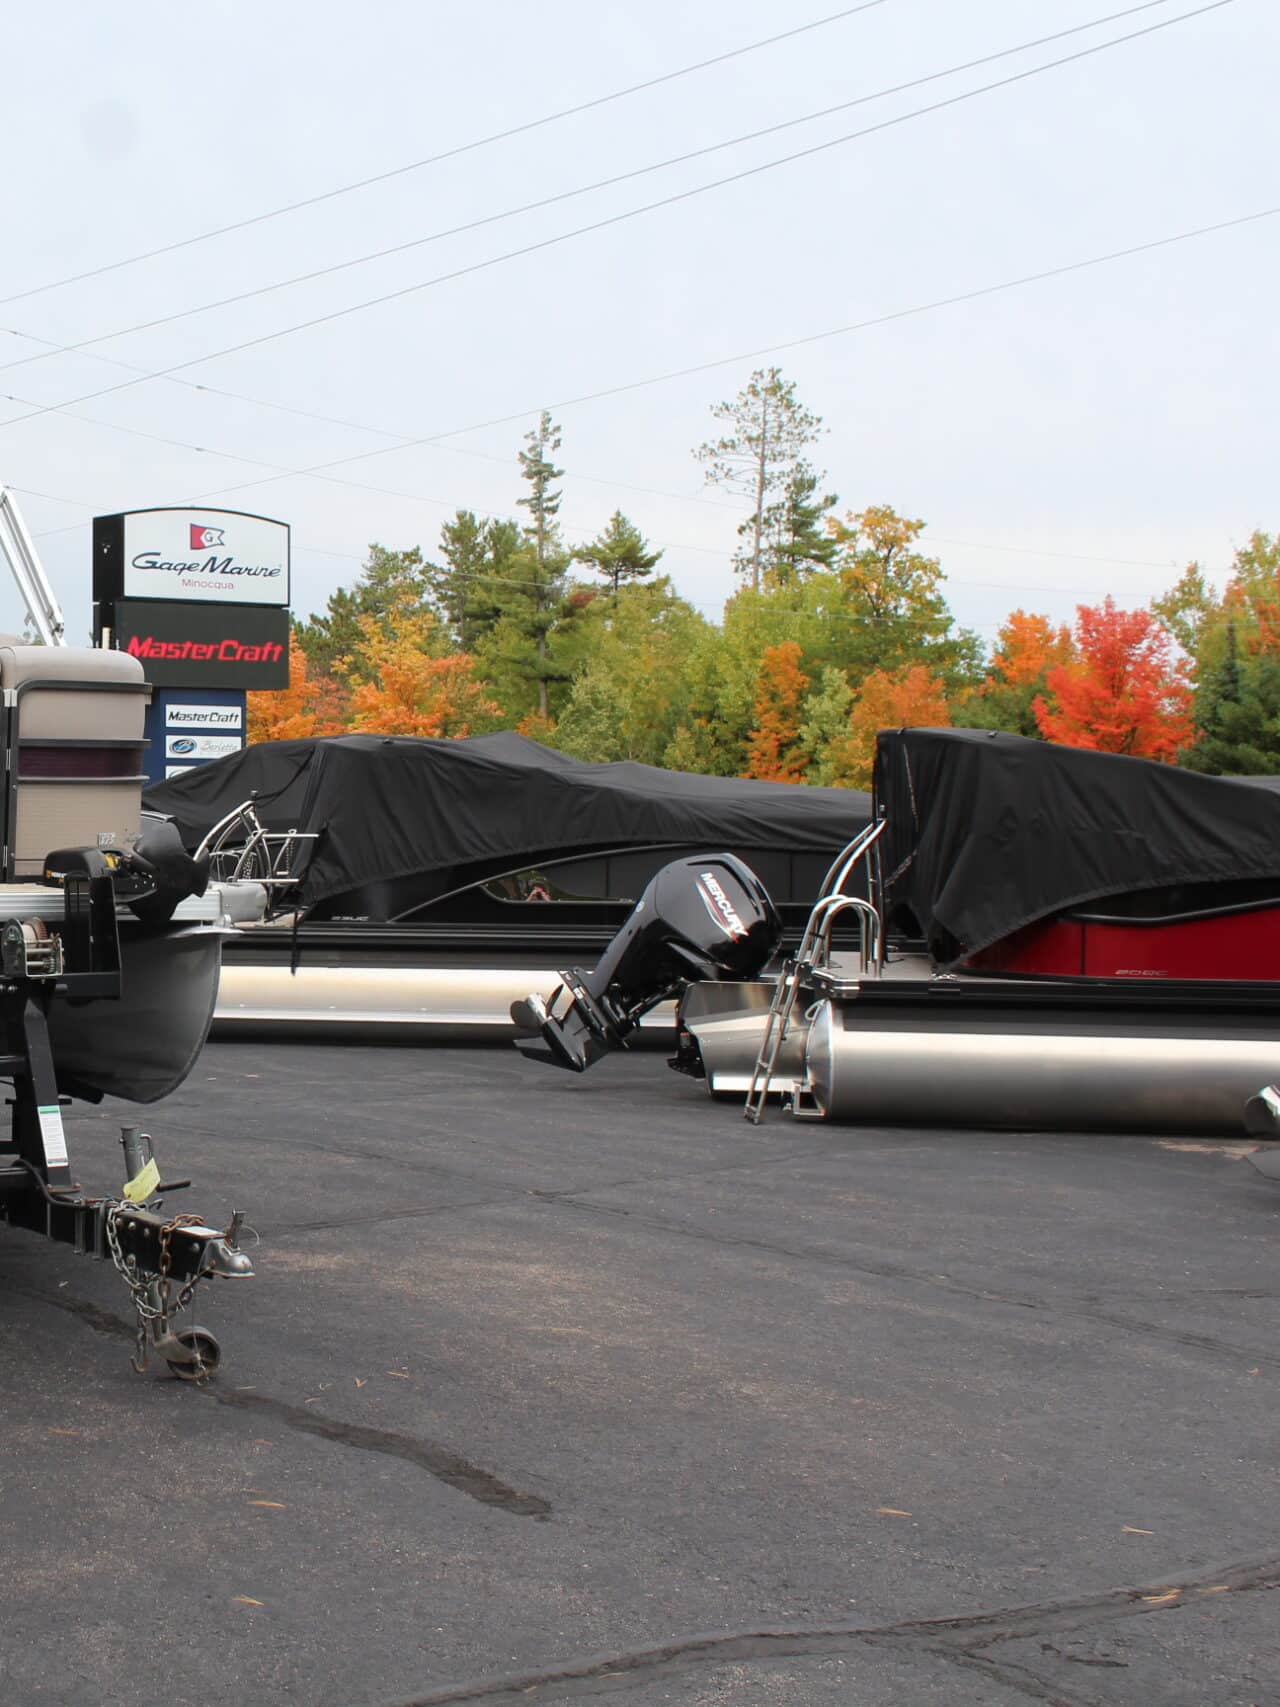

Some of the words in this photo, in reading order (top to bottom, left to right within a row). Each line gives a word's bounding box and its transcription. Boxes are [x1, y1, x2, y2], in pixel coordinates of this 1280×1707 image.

[132, 551, 200, 576] Gage
[200, 556, 282, 578] Marine
[182, 578, 234, 590] Minocqua
[127, 635, 284, 663] MasterCraft
[168, 711, 239, 723] MasterCraft
[700, 872, 749, 936] MERCURY
